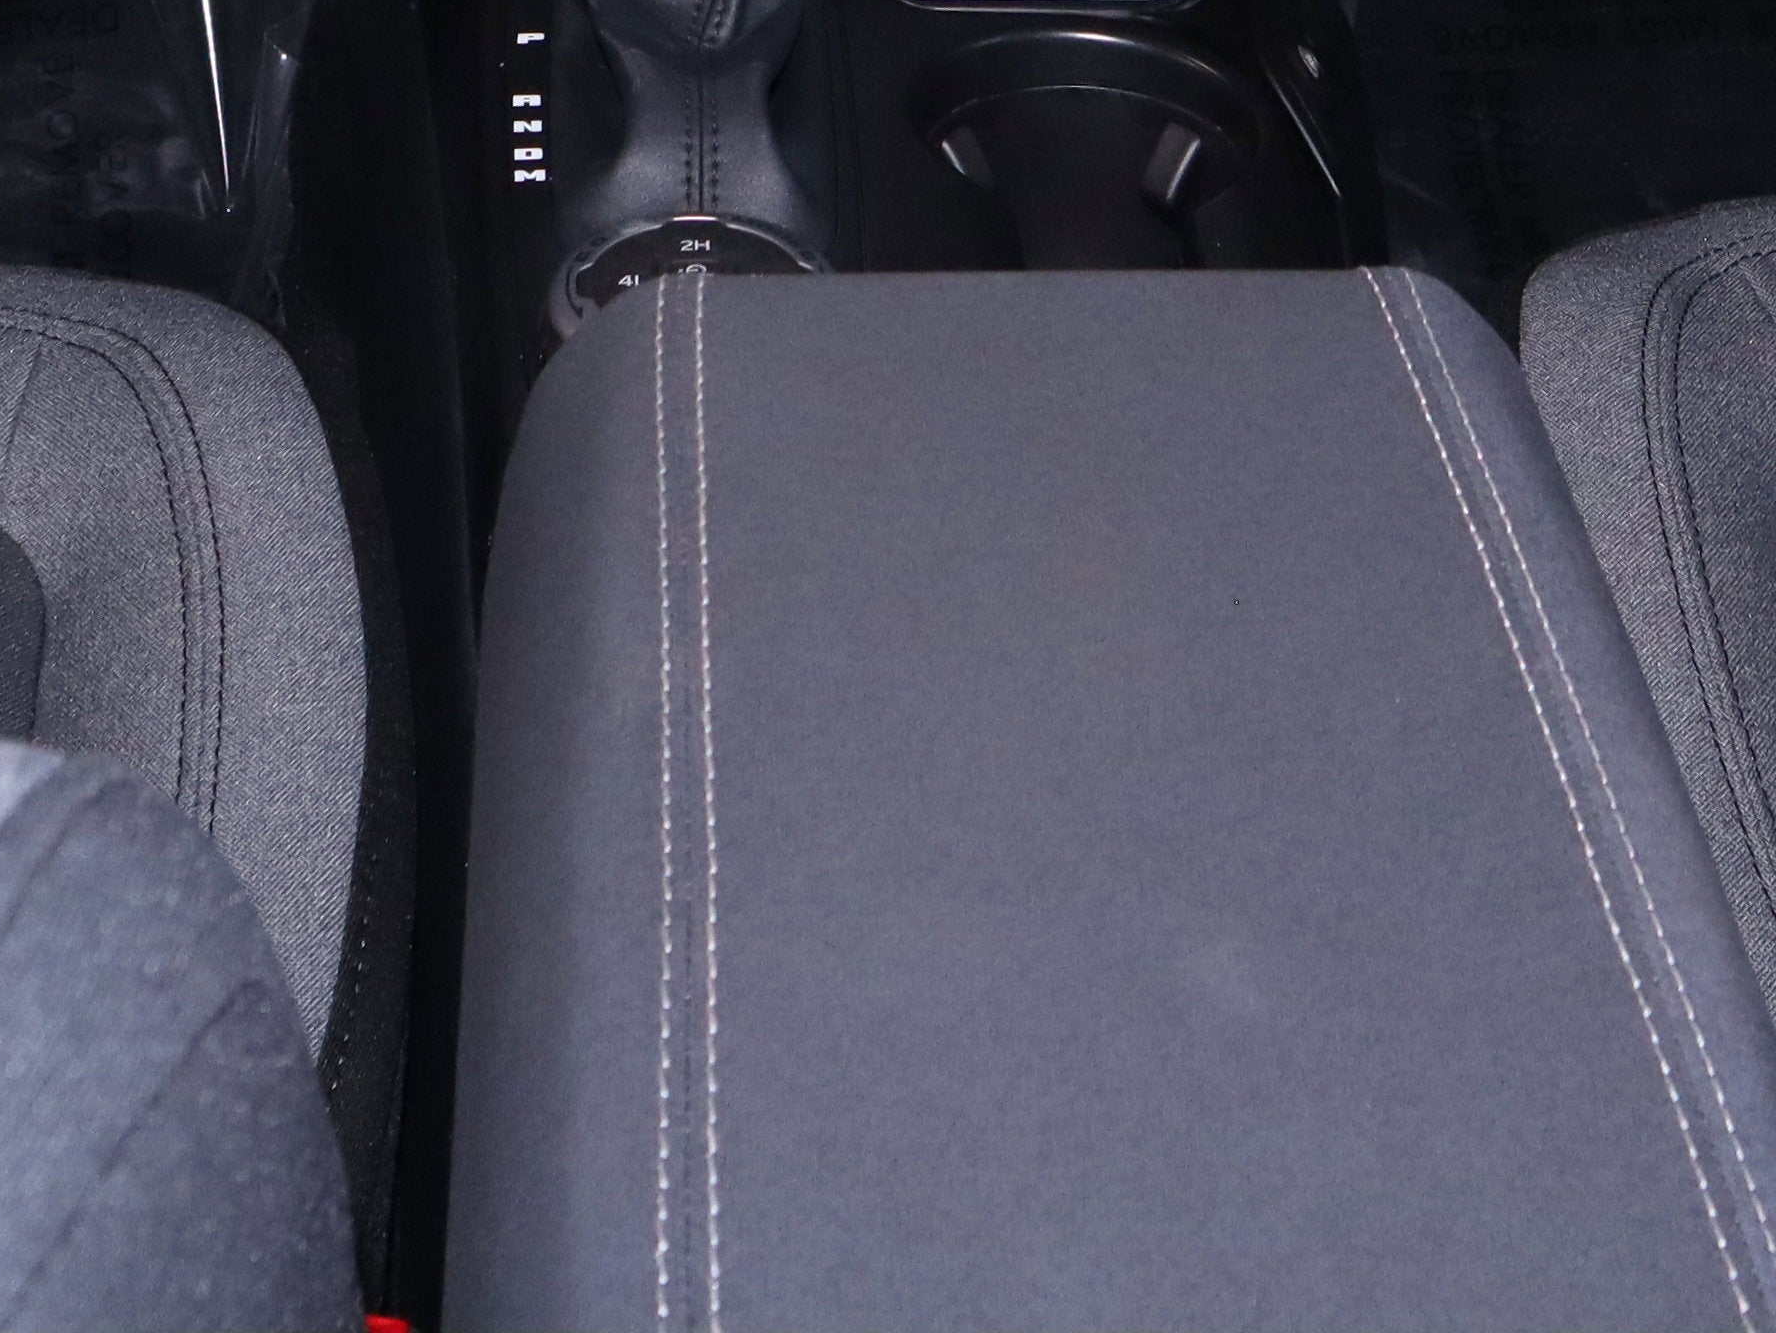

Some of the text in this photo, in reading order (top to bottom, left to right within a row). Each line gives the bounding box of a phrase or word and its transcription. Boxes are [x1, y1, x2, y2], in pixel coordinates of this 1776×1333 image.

[517, 33, 545, 44] P
[513, 120, 542, 133] N
[514, 148, 543, 161] D
[514, 169, 546, 182] M
[680, 239, 711, 252] 2H
